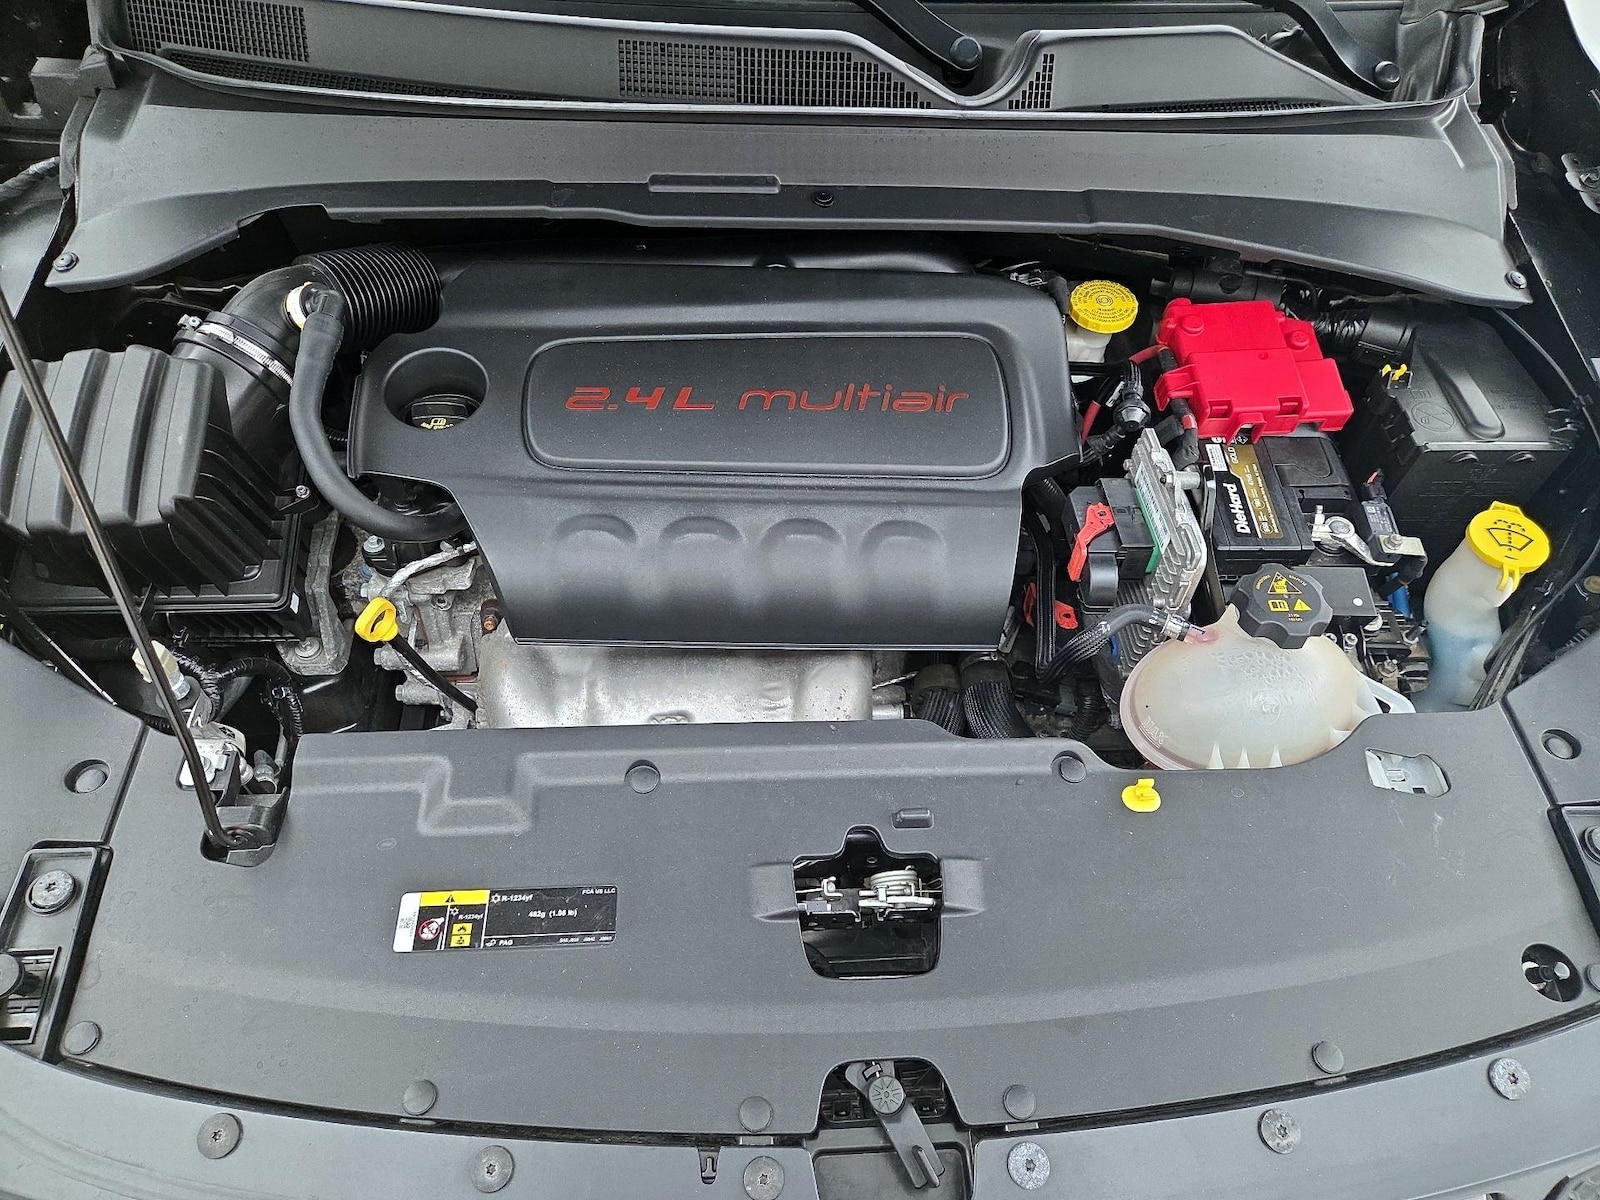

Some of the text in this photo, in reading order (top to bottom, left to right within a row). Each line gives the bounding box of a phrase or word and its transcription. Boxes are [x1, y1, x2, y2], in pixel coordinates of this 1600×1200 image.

[737, 382, 969, 413] multiair
[1227, 446, 1239, 464] GOLD
[1222, 482, 1252, 534] DieHard
[501, 893, 534, 903] R-1234yf
[458, 913, 484, 921] R-1234yf
